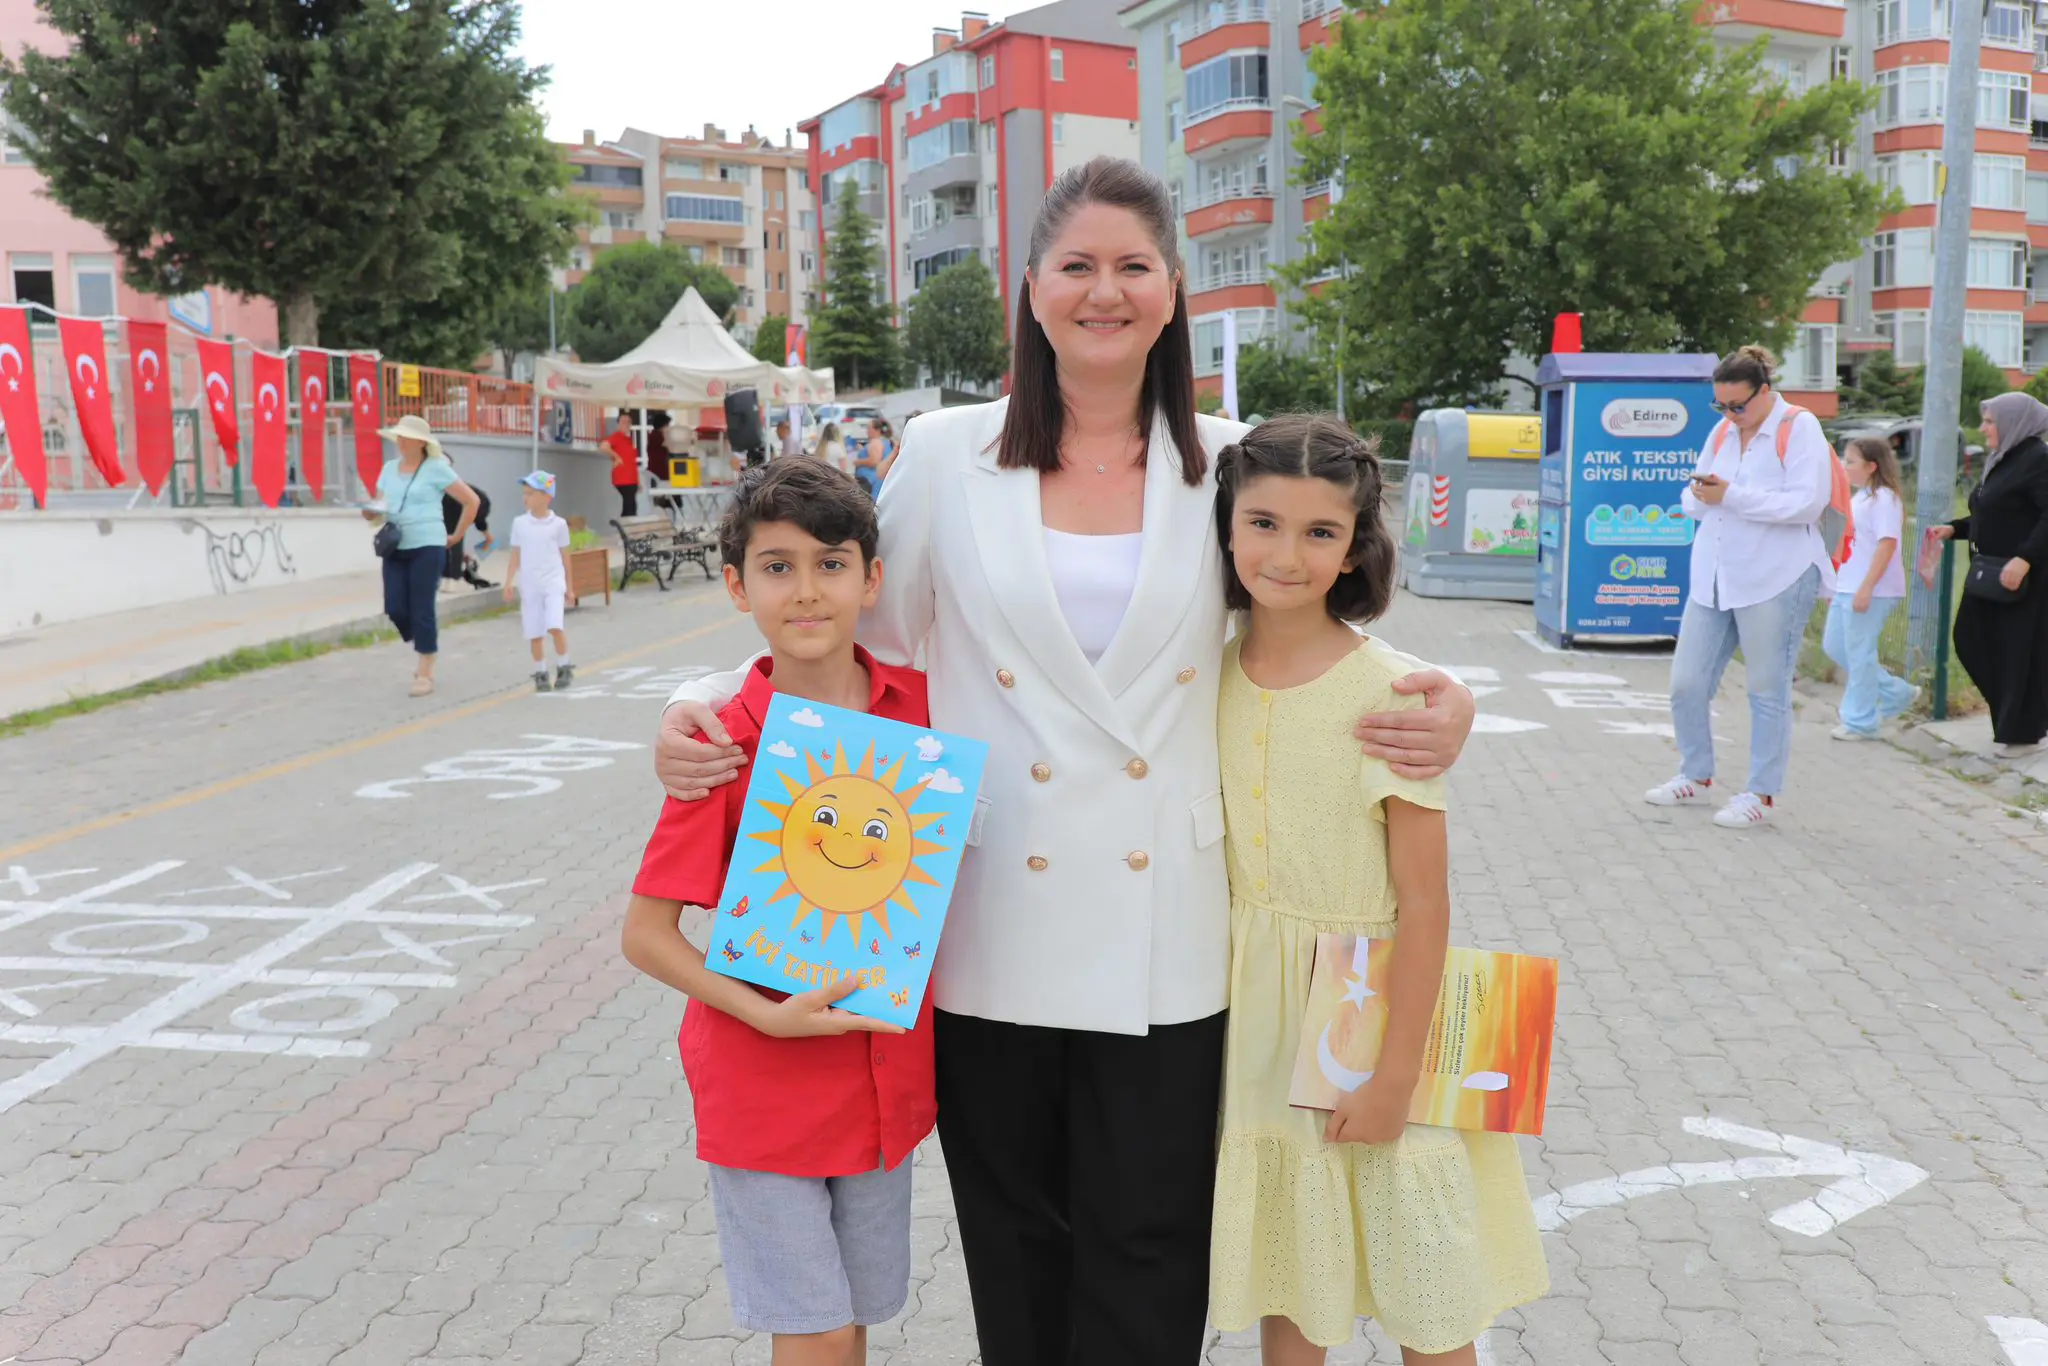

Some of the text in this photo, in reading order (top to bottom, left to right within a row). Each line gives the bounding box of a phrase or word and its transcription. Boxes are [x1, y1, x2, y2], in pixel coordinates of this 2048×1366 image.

[1633, 410, 1678, 421] Edirne
[1583, 451, 1622, 464] ATIK
[1583, 465, 1695, 481] GİYSİ KUTUS
